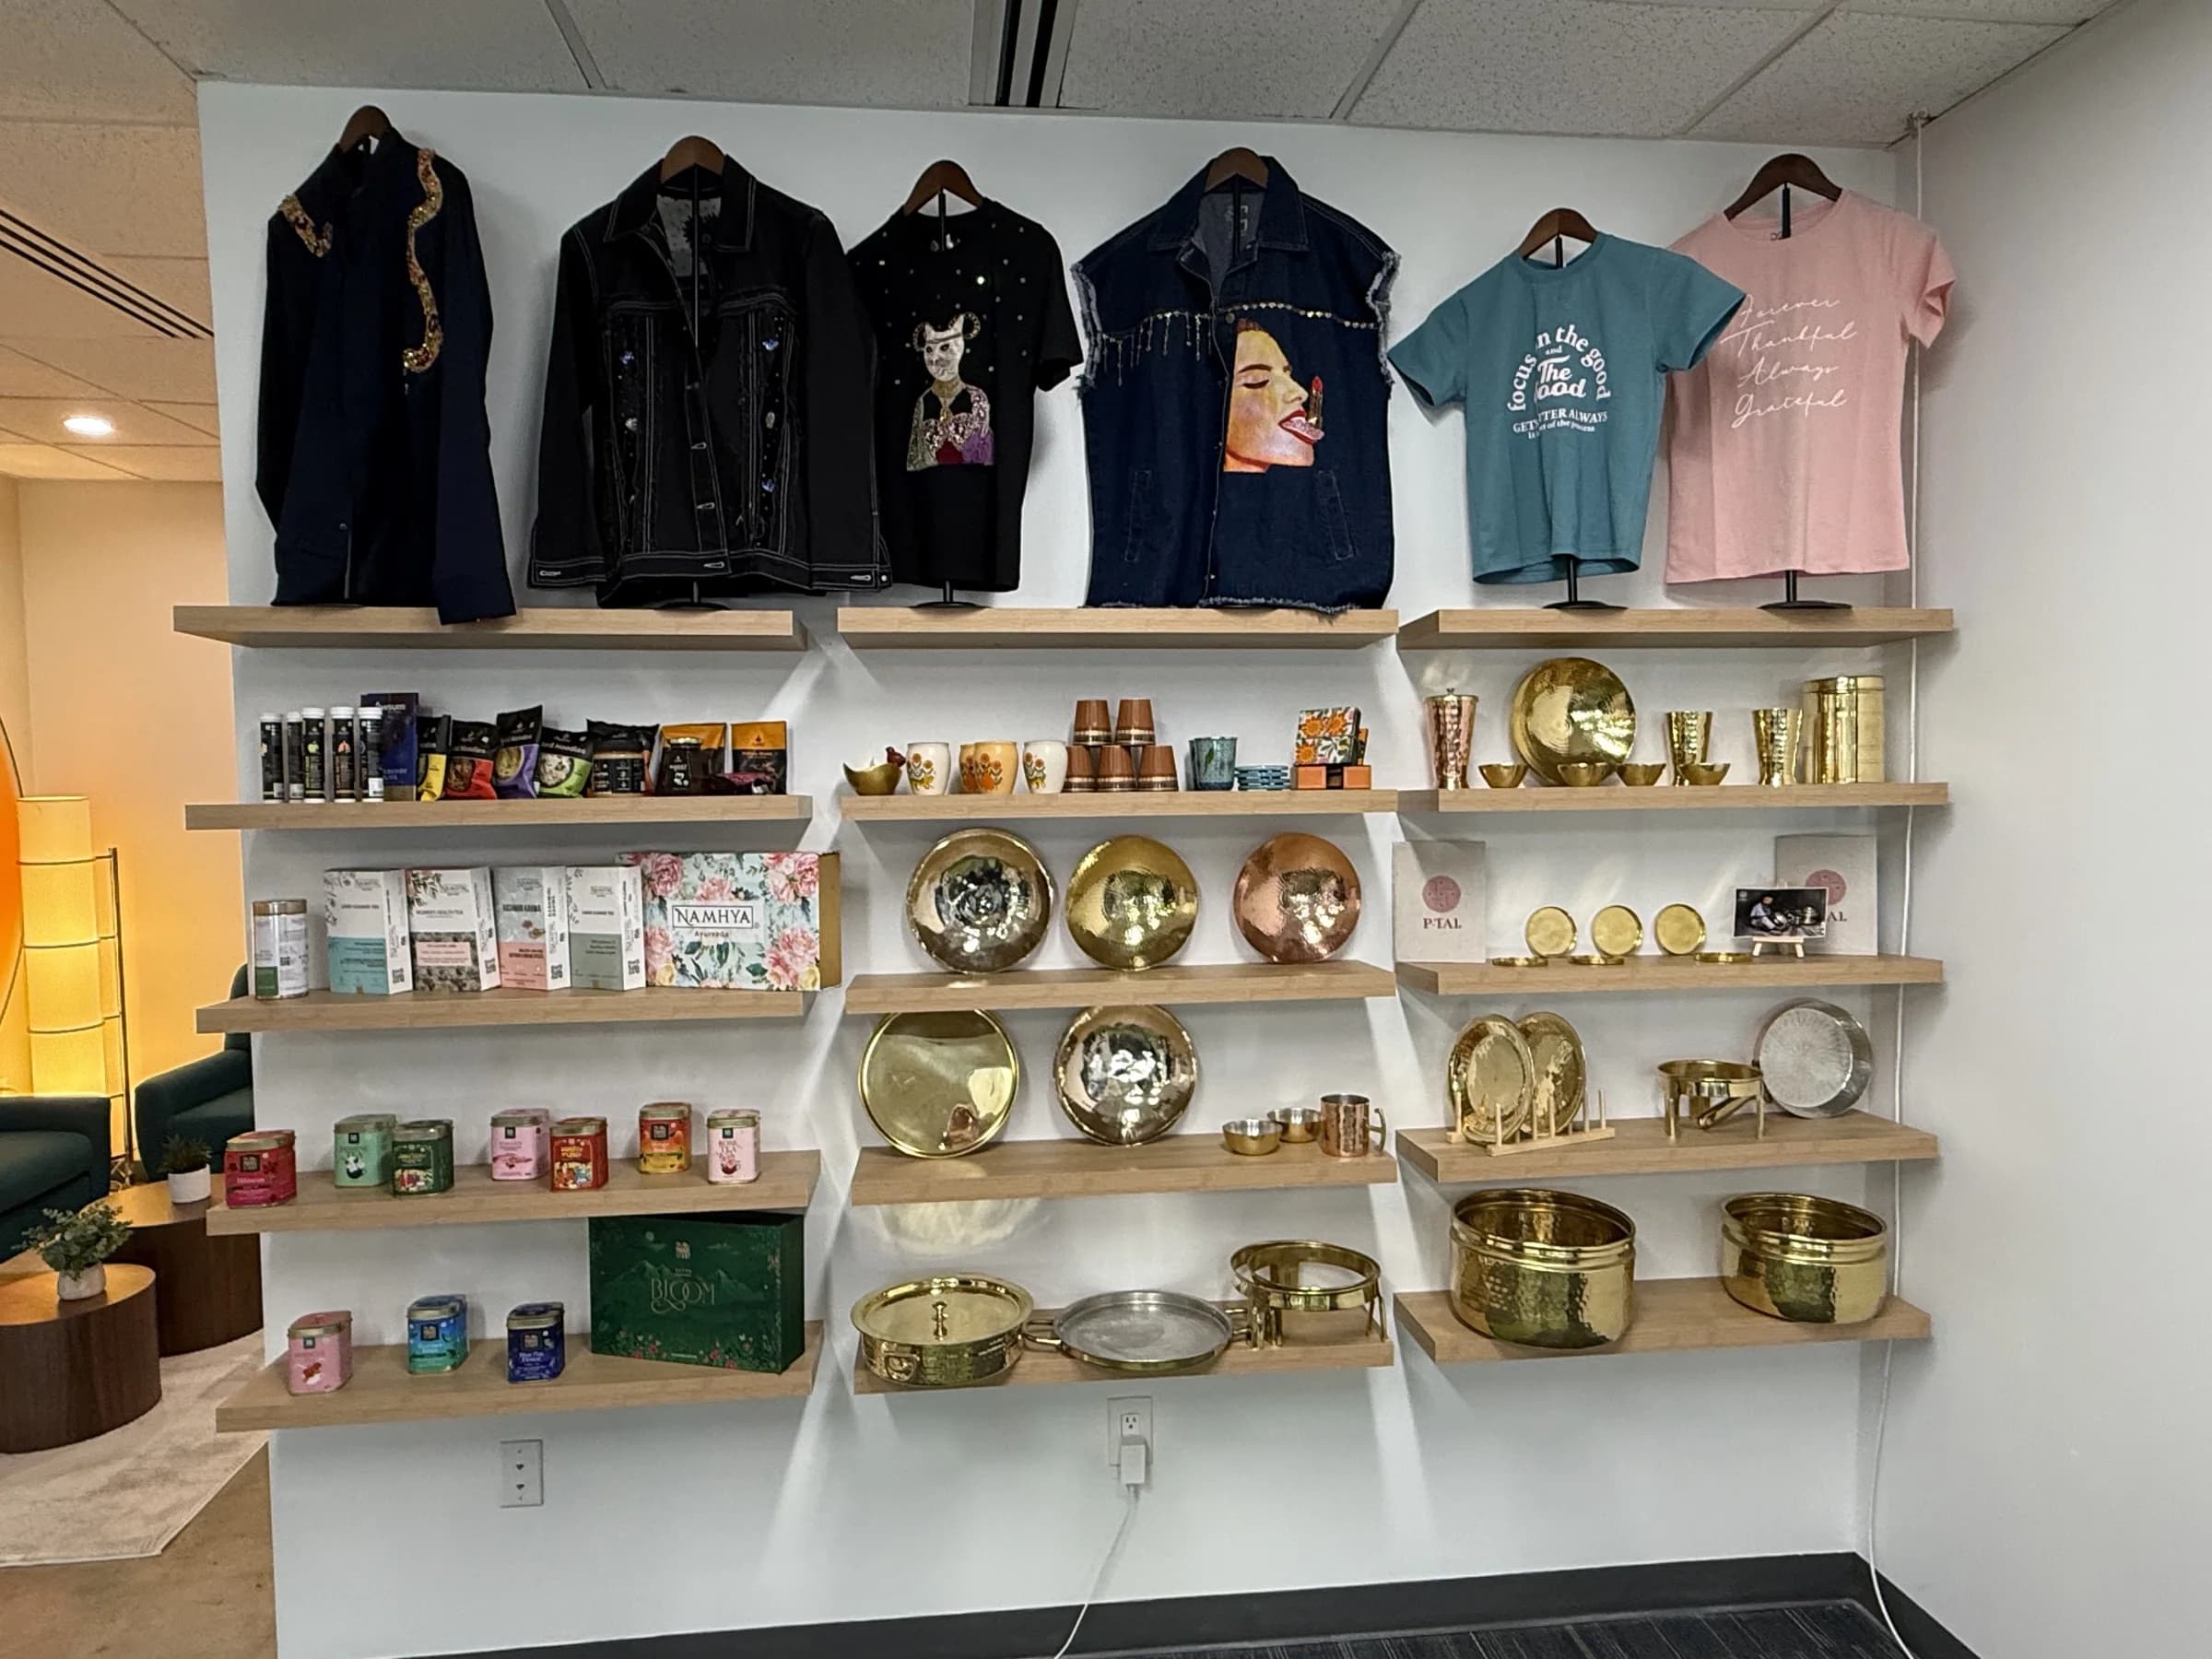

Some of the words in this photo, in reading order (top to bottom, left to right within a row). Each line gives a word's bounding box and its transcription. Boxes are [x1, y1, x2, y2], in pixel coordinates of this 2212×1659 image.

[1740, 293, 1841, 329] Forever
[1545, 345, 1562, 356] and
[1720, 320, 1858, 359] Thankful
[1507, 354, 1537, 412] focus
[1536, 331, 1551, 349] n
[1555, 324, 1589, 352] the
[1580, 347, 1612, 402] good
[1537, 355, 1572, 384] The
[1736, 356, 1840, 389] Always
[1533, 378, 1587, 403] ood
[1569, 409, 1608, 424] ALWAYS
[1731, 389, 1849, 429] Grateful
[674, 908, 751, 927] NAMHYA
